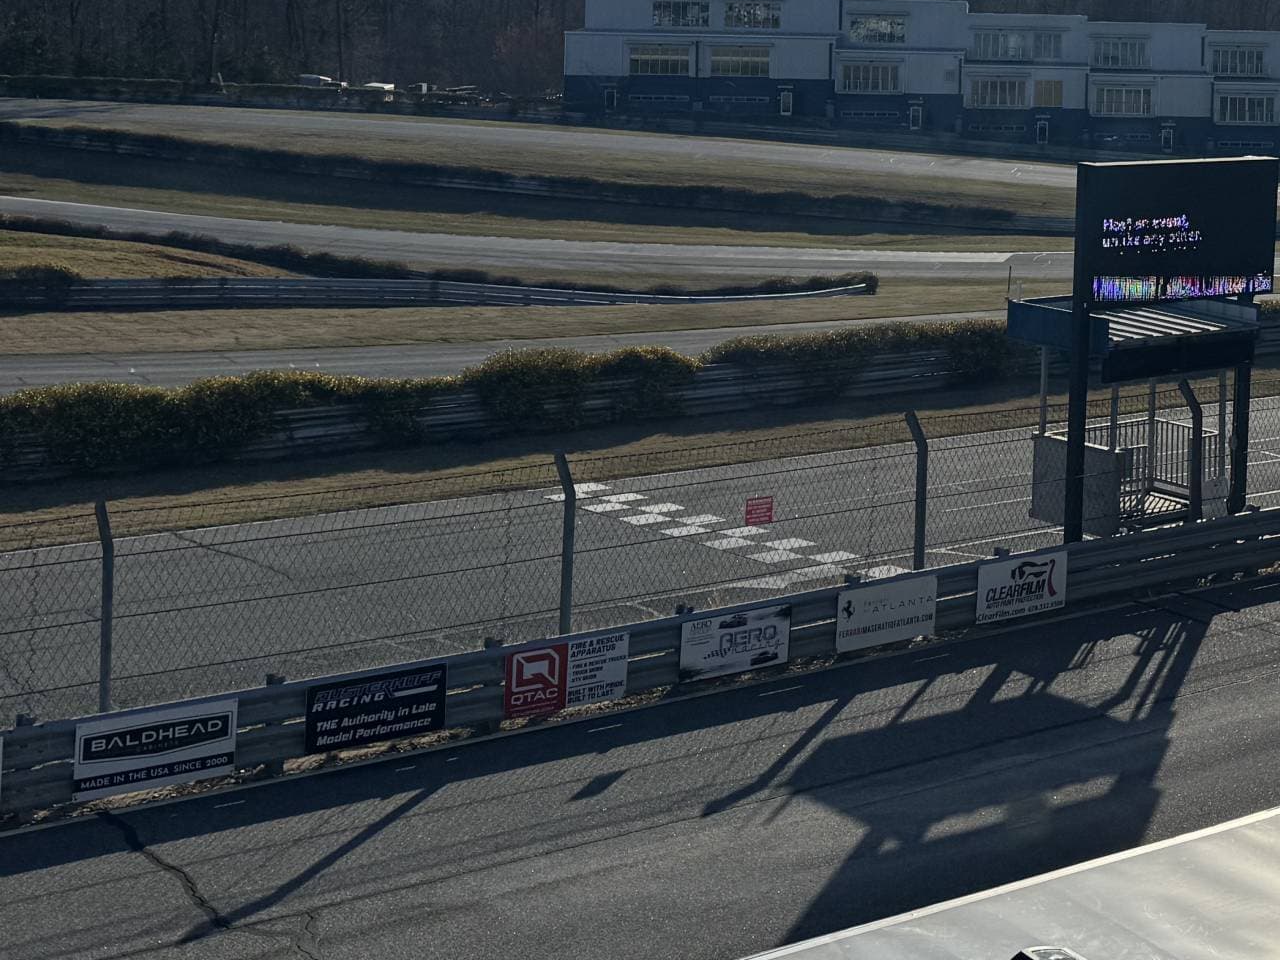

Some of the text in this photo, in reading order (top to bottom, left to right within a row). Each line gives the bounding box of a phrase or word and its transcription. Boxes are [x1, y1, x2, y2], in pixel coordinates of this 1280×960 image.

[985, 578, 1047, 603] CLEARFILM
[872, 595, 933, 614] ATLANTA
[570, 634, 625, 651] FIRE & RESCUE
[719, 624, 777, 650] AERO
[570, 644, 616, 659] APPARATUS
[312, 691, 386, 713] RACING
[511, 687, 559, 705] QTAC
[567, 695, 586, 705] BUILT
[587, 693, 597, 701] TO
[568, 688, 586, 698] BUILT
[316, 702, 437, 732] THE Authority in Late
[91, 720, 223, 752] BALDHEAD
[316, 717, 432, 746] Model Performance
[80, 755, 229, 790] MADE IN THE USA SINCE 2000
